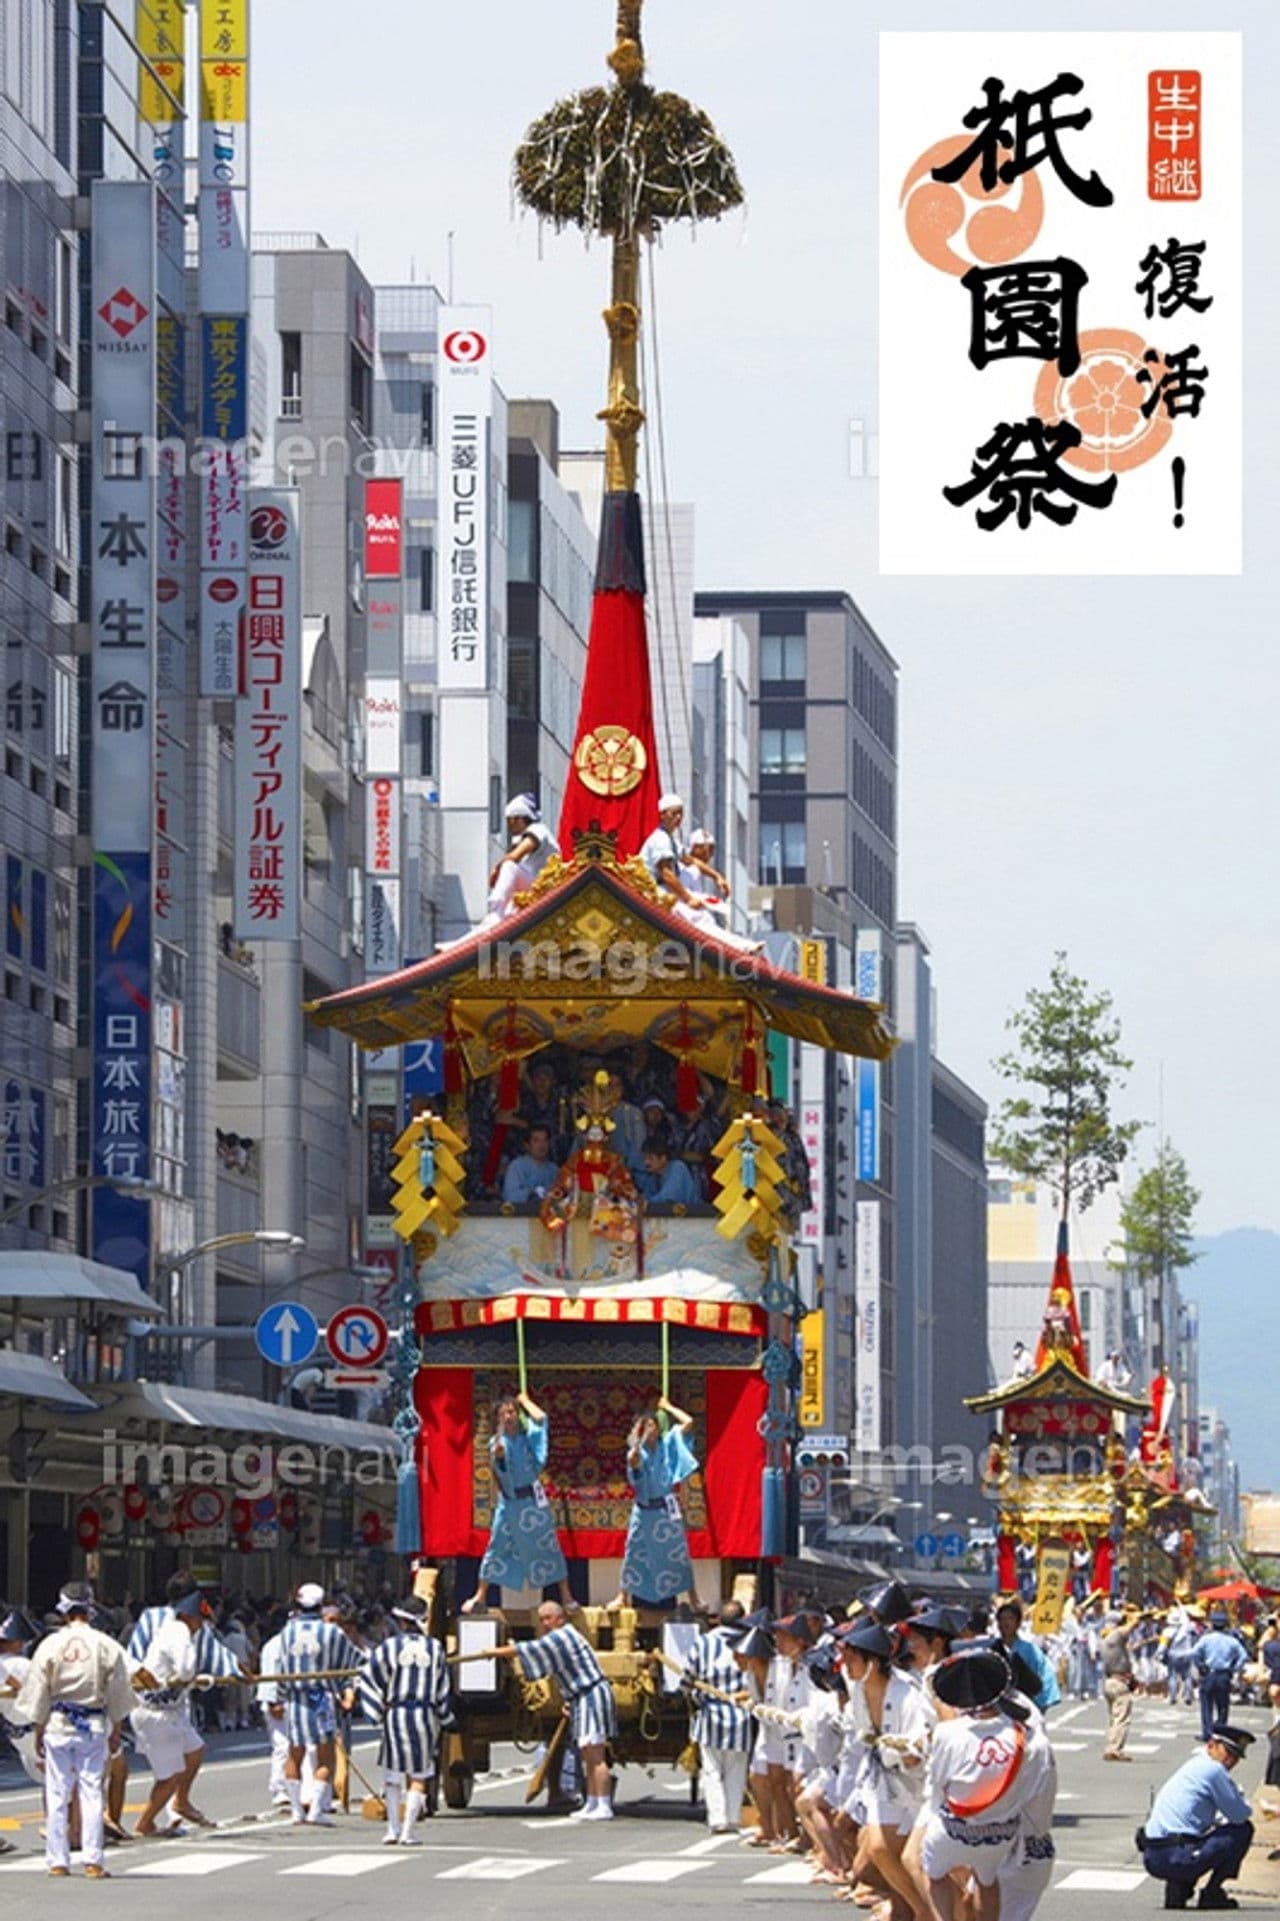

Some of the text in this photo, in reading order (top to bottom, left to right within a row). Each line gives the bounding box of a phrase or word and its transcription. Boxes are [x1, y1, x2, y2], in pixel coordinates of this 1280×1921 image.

[213, 0, 234, 53] 工房
[98, 341, 148, 352] NISSAY
[211, 320, 237, 438] 東京アカデミー
[98, 431, 148, 732] 日本生命
[451, 414, 477, 662] 三菱UFJ信託銀行
[248, 575, 288, 919] 日興コーディアル証券
[102, 1014, 142, 1178] 日本旅行
